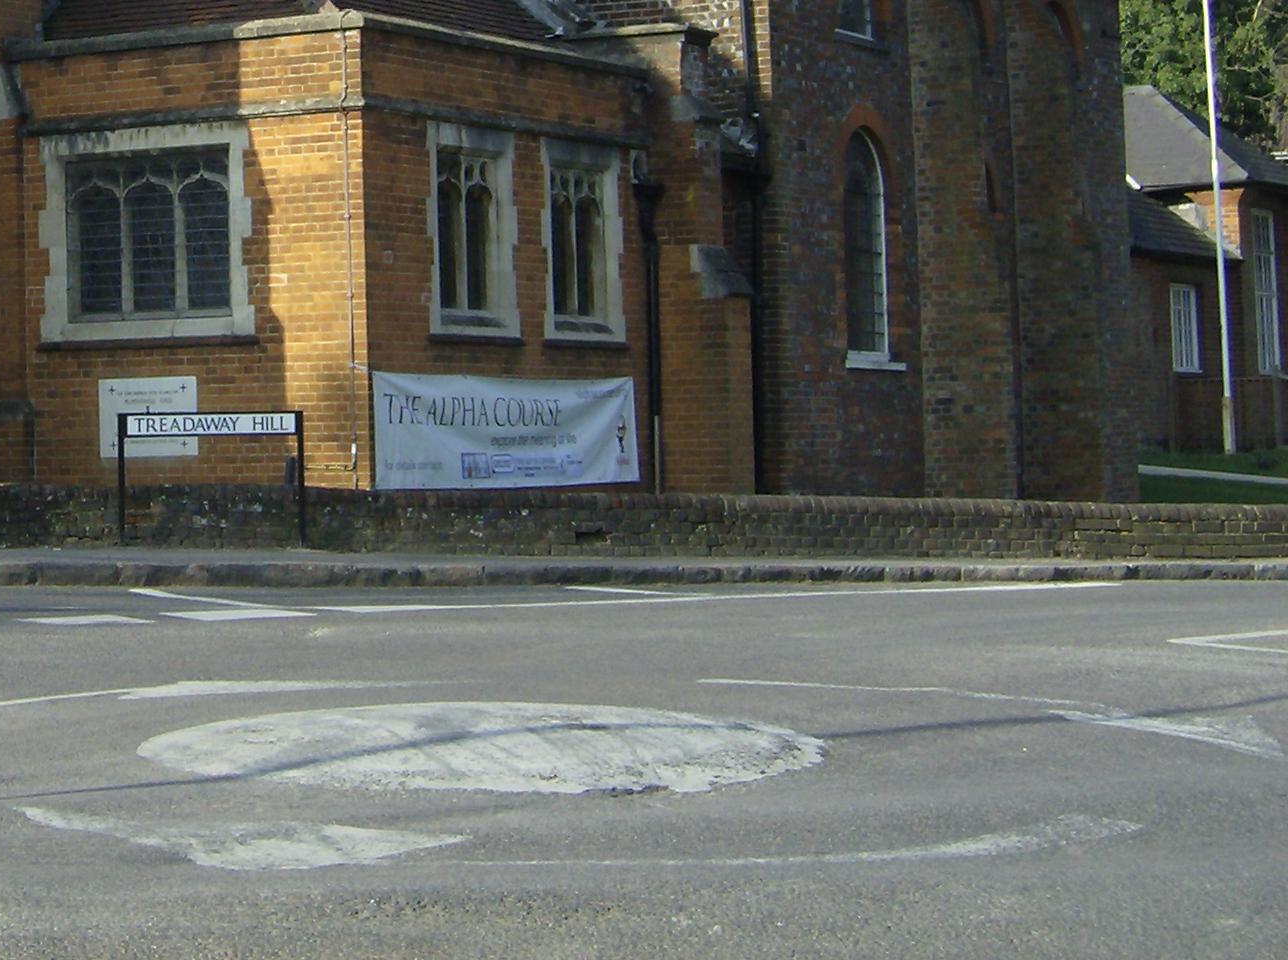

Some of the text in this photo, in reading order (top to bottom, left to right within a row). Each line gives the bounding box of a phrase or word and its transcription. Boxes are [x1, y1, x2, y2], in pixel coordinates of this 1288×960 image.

[383, 393, 562, 427] THE ALPHA COURSE
[134, 416, 289, 433] TREADAWAY HILL
